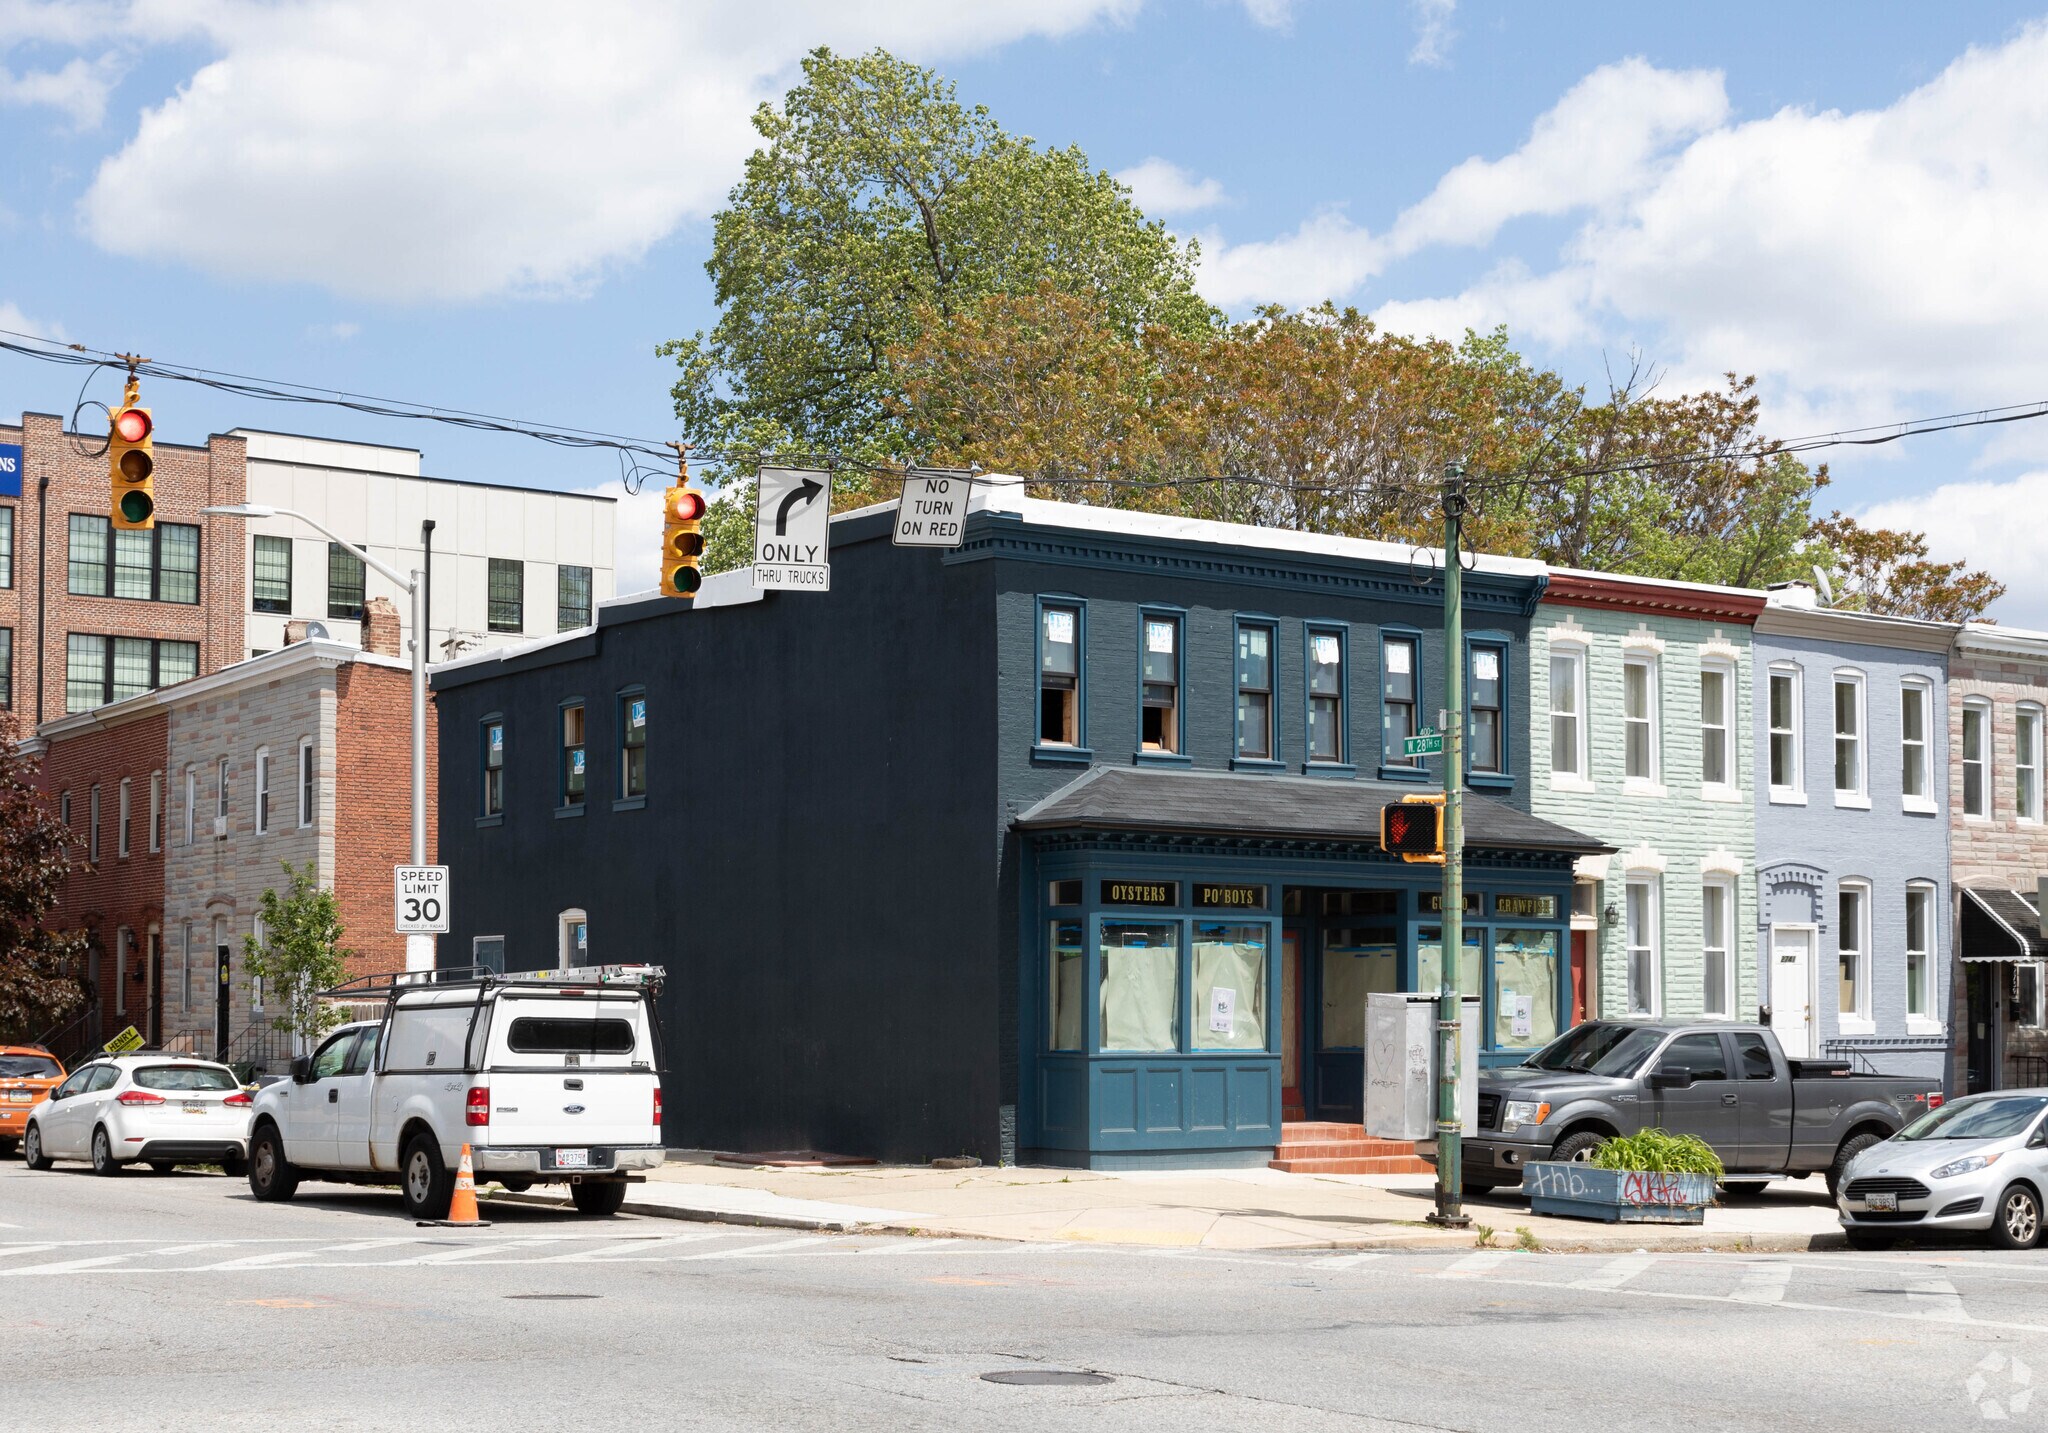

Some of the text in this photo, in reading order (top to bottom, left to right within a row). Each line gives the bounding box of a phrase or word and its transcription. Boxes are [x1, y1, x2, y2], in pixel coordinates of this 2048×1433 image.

[925, 480, 949, 494] NO
[915, 501, 953, 515] TURN
[902, 521, 958, 537] ON RED
[762, 543, 819, 563] ONLY
[757, 569, 824, 585] THRU TRUCKS
[1416, 738, 1433, 753] 28TH
[401, 871, 443, 881] SPEED
[404, 884, 439, 894] LIMIT
[1112, 885, 1166, 902] OYSTERS
[1203, 888, 1254, 904] PO'BOYS
[403, 898, 441, 922] 30
[1498, 898, 1551, 914] CRAWFISH
[108, 1029, 134, 1052] HENRY
[1896, 1094, 1926, 1102] STX
